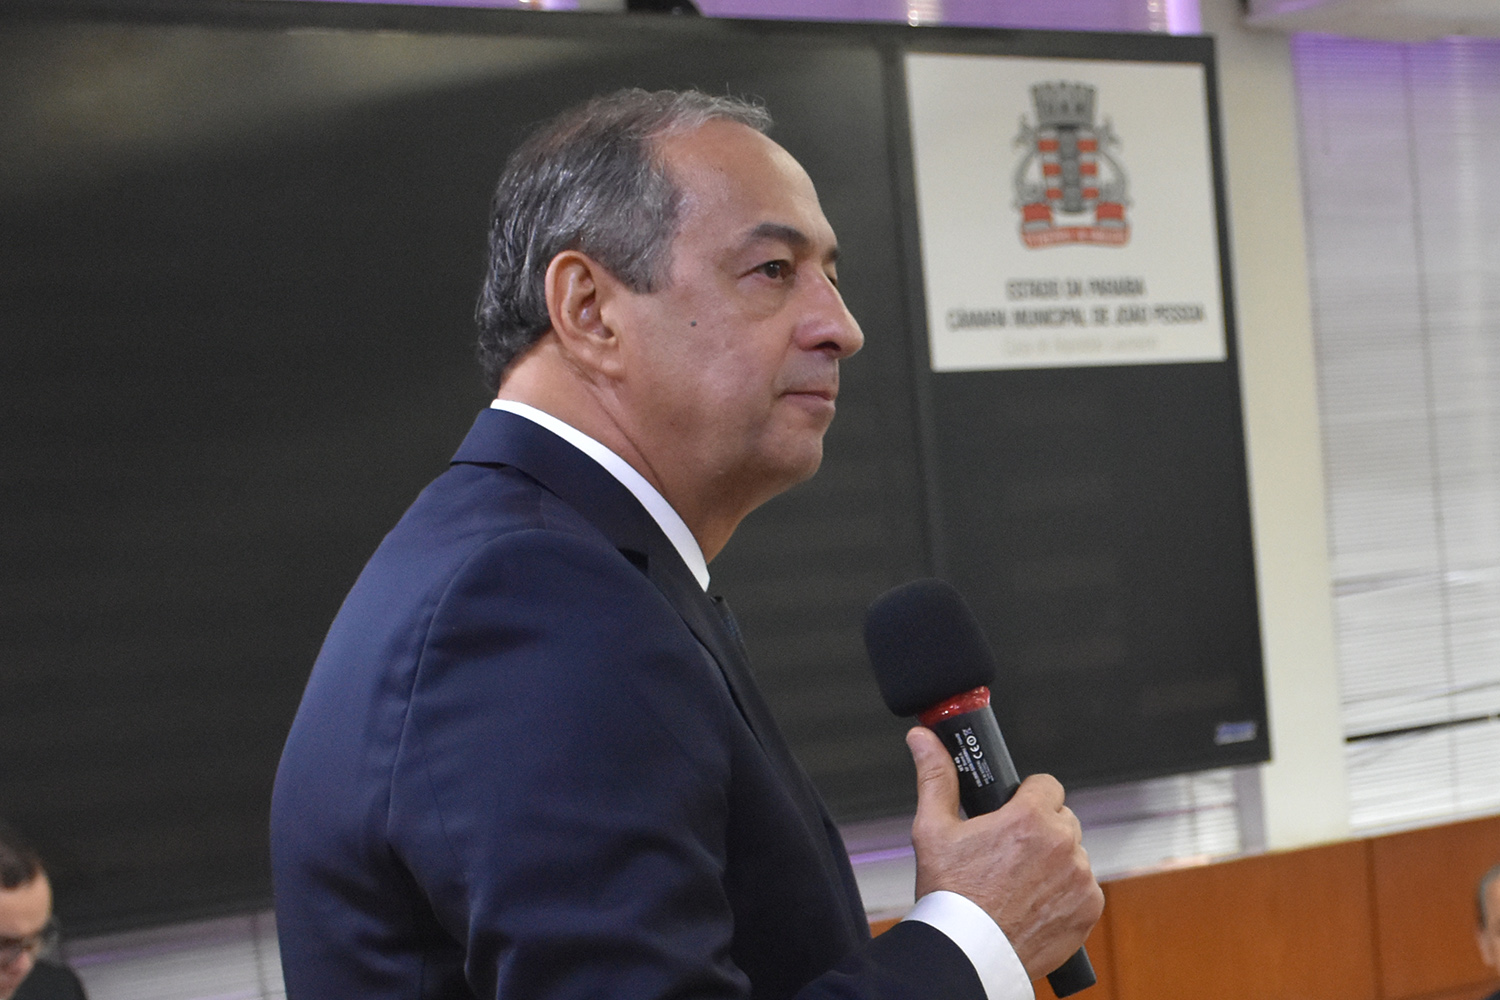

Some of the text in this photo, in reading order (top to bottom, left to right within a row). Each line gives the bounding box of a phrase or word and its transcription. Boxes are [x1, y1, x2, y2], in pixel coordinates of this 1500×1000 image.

[1007, 279, 1060, 299] ESTADO
[1065, 279, 1083, 299] DA
[1011, 305, 1087, 328] MUNICIPAL
[1091, 305, 1109, 327] DE
[1153, 302, 1205, 325] PESSOA
